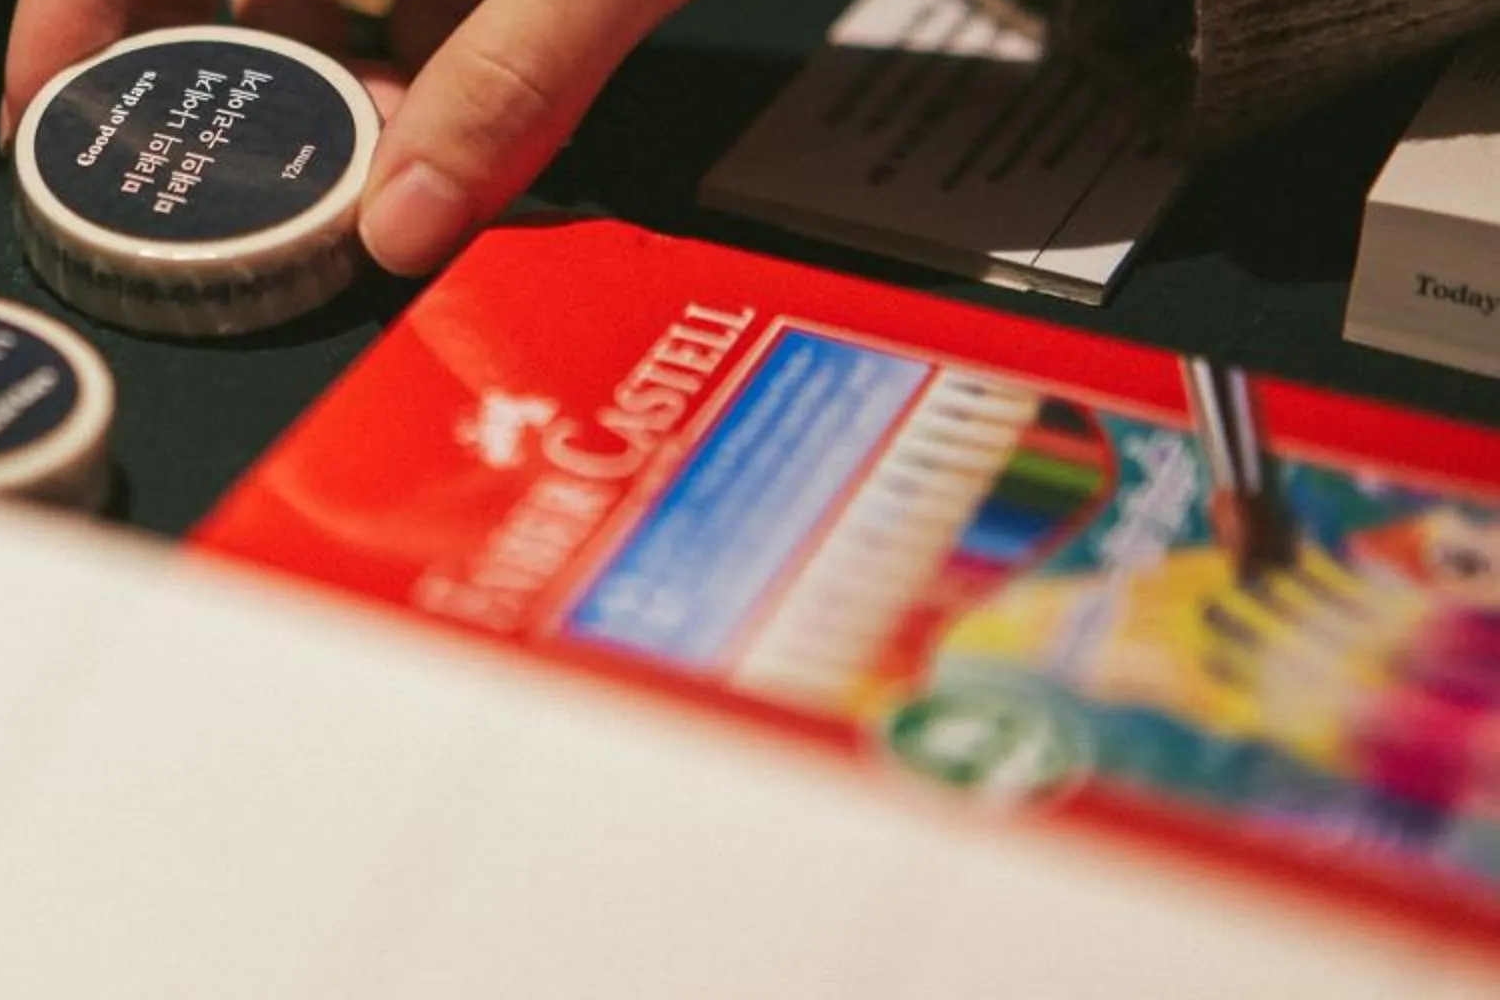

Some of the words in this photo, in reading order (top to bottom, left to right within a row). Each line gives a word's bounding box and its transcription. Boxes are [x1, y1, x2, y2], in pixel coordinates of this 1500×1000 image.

[76, 123, 117, 168] Good
[120, 70, 158, 107] days
[121, 132, 183, 196] 미래의
[166, 69, 228, 131] 나에게
[153, 151, 216, 215] 미래의
[198, 69, 274, 150] 우리에게
[280, 143, 317, 181] 12mm
[1412, 271, 1500, 318] Today
[540, 301, 757, 481] CASTELL
